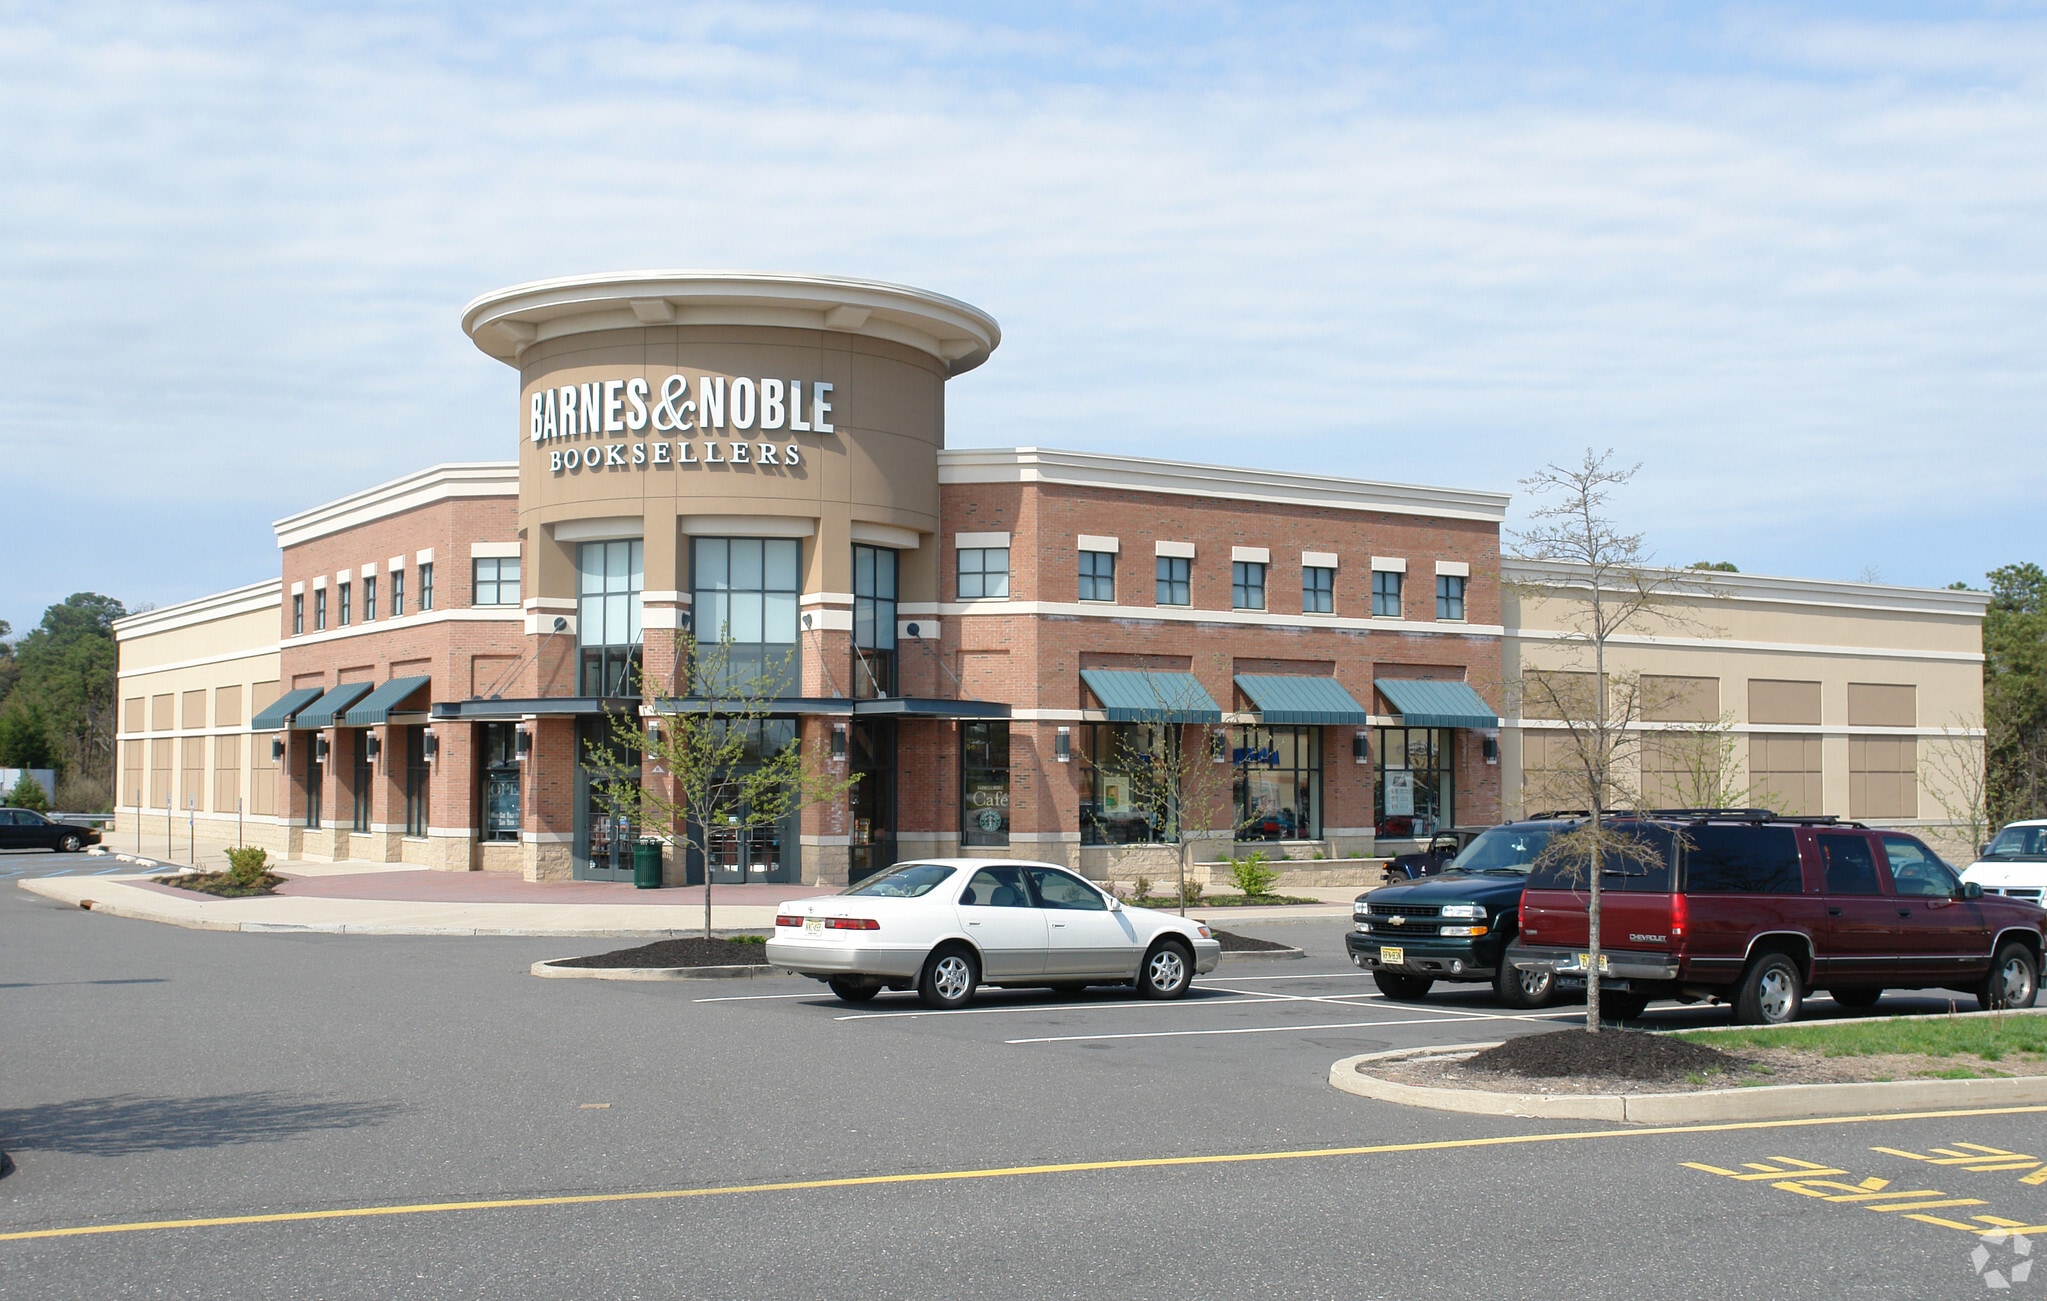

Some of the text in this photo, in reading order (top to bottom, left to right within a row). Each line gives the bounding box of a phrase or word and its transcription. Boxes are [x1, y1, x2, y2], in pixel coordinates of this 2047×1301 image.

[549, 441, 801, 473] BOOKSELLERS
[490, 782, 520, 796] OPE
[972, 790, 1009, 807] Café
[1629, 933, 1667, 943] CHEVROLET
